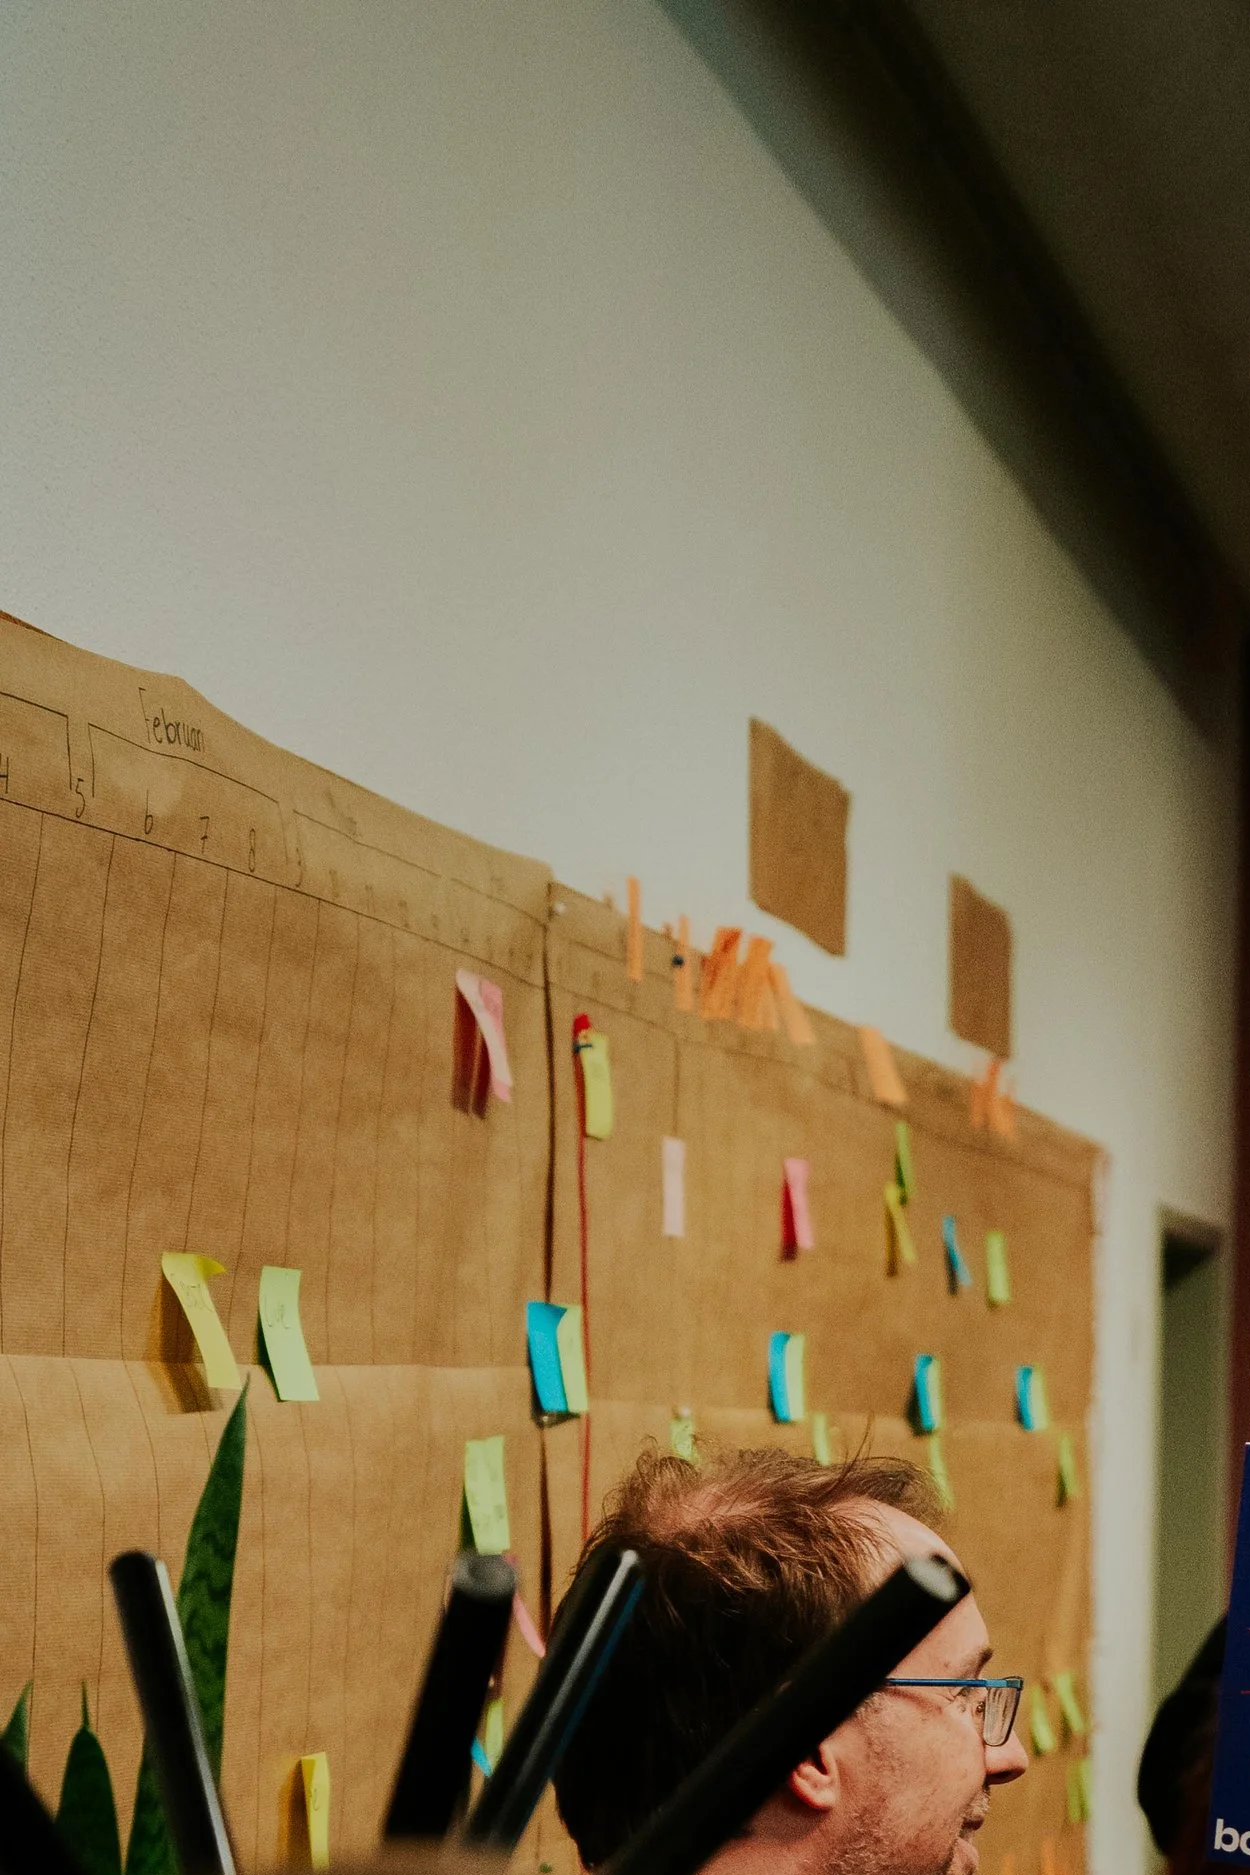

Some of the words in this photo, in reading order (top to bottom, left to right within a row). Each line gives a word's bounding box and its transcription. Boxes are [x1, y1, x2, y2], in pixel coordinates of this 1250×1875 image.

[75, 777, 86, 819] 5
[199, 815, 210, 855] 7
[248, 828, 256, 873] 8
